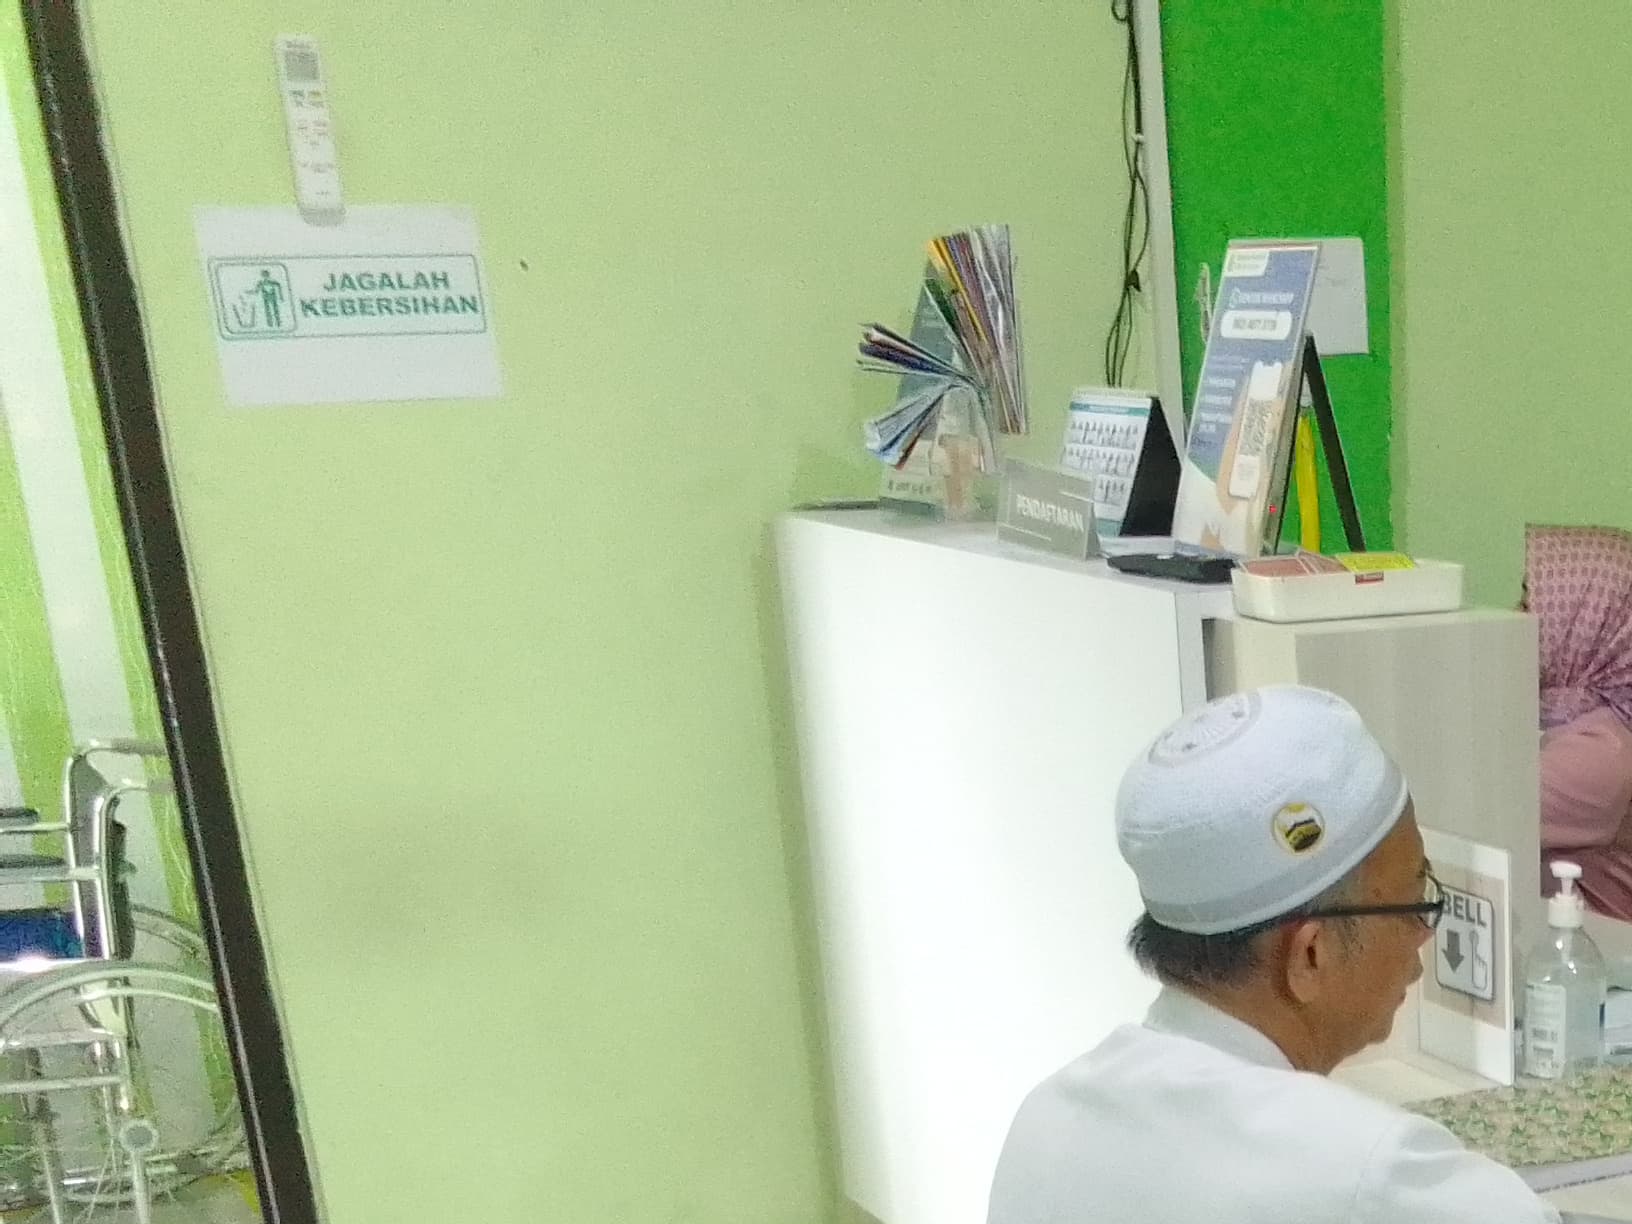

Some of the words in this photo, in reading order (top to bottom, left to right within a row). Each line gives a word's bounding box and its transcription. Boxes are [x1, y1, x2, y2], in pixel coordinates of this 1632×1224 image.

[323, 271, 450, 292] JAGALAH
[300, 294, 480, 319] KEBERSIHAN
[1016, 493, 1085, 533] PENDAFTARAN
[1442, 894, 1487, 927] BELL
